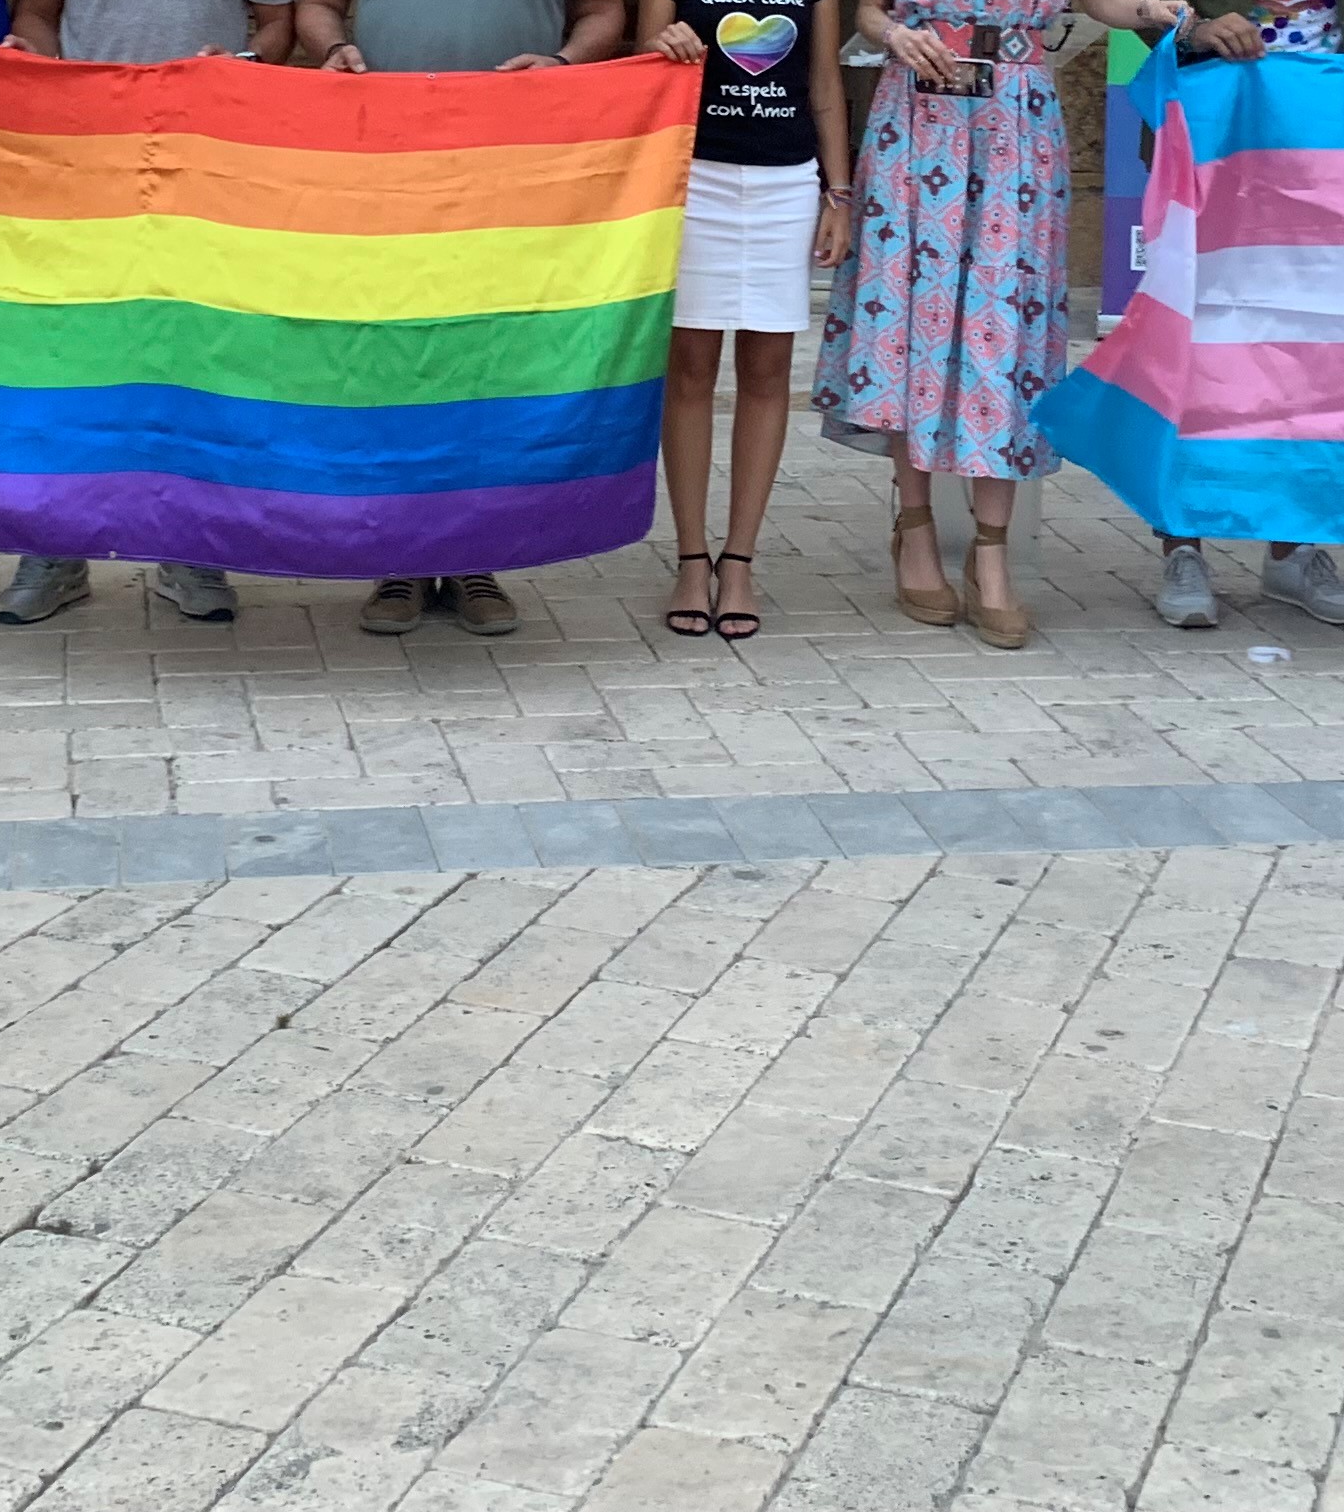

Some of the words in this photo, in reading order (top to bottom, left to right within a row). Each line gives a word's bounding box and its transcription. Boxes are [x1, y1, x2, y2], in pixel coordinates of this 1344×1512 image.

[720, 82, 787, 105] respeta
[706, 104, 745, 117] con
[752, 103, 796, 118] Amor
